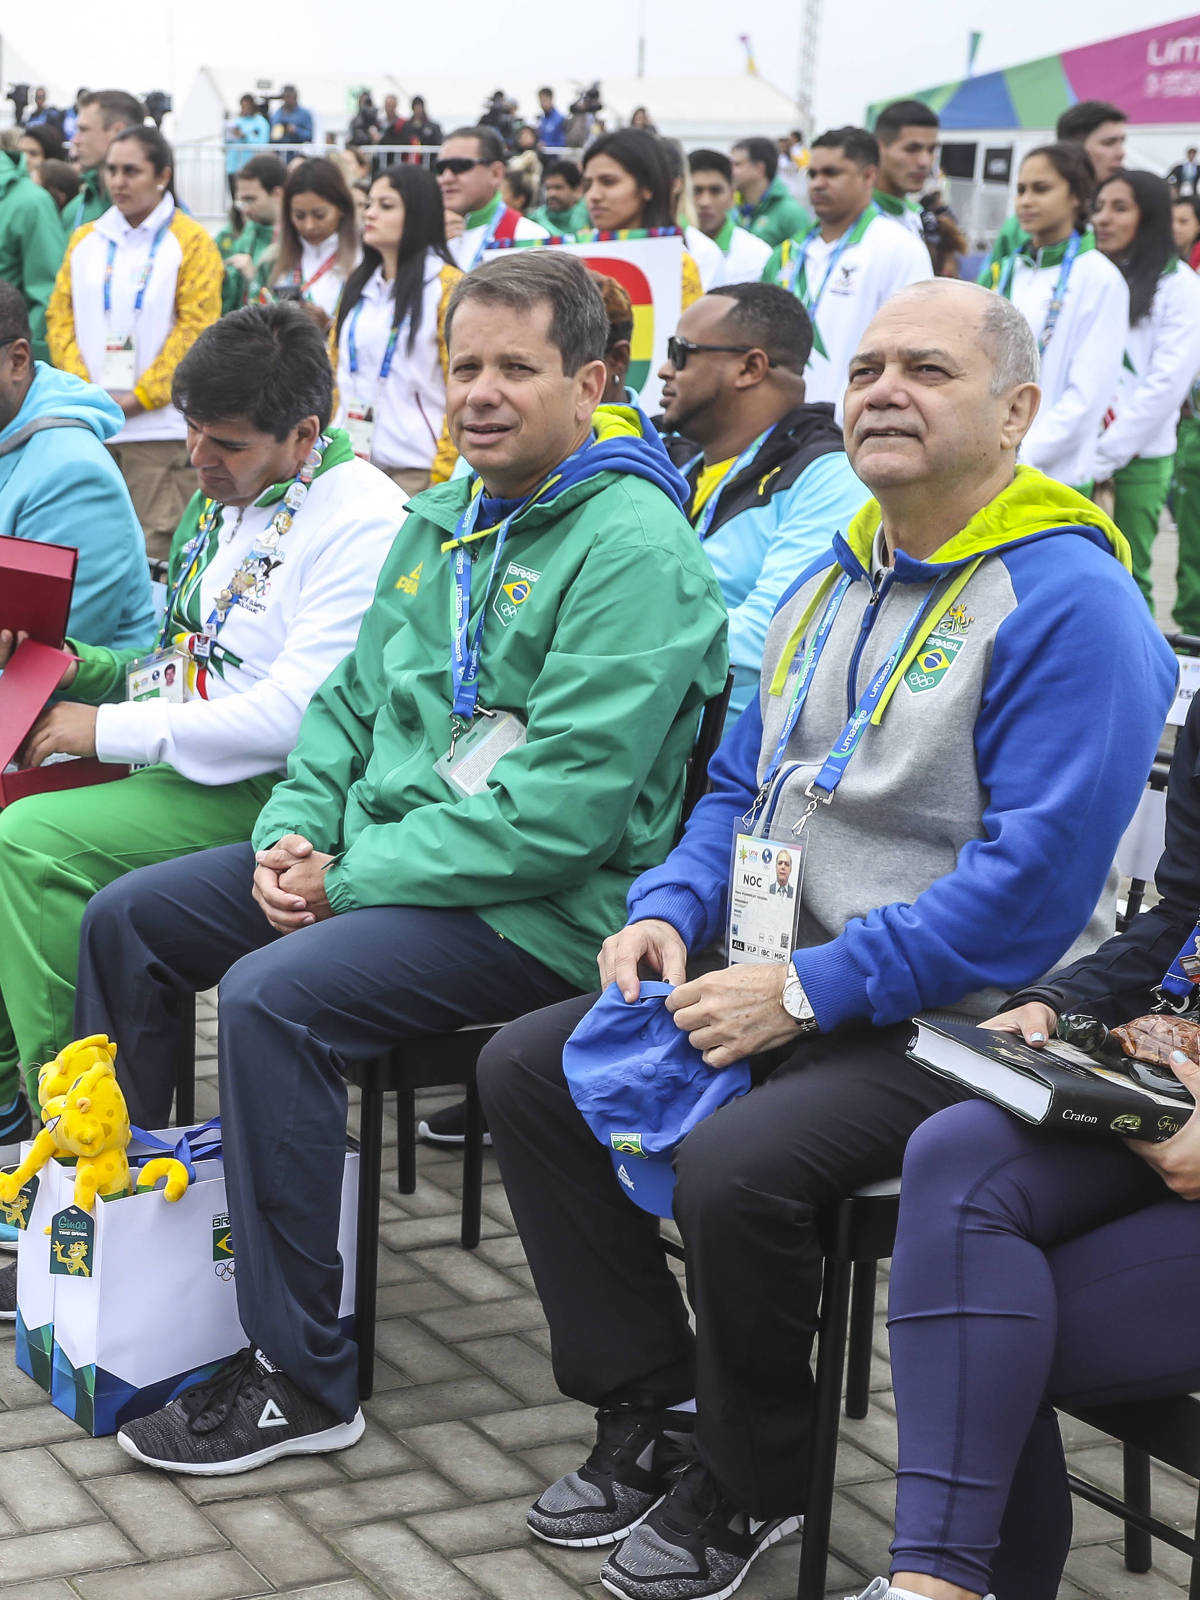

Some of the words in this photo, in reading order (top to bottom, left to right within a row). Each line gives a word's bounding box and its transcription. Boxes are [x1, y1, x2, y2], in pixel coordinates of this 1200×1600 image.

[743, 874, 763, 888] NOC
[774, 952, 786, 962] MPC
[1062, 1109, 1098, 1124] Craton
[58, 1216, 87, 1231] Ginga
